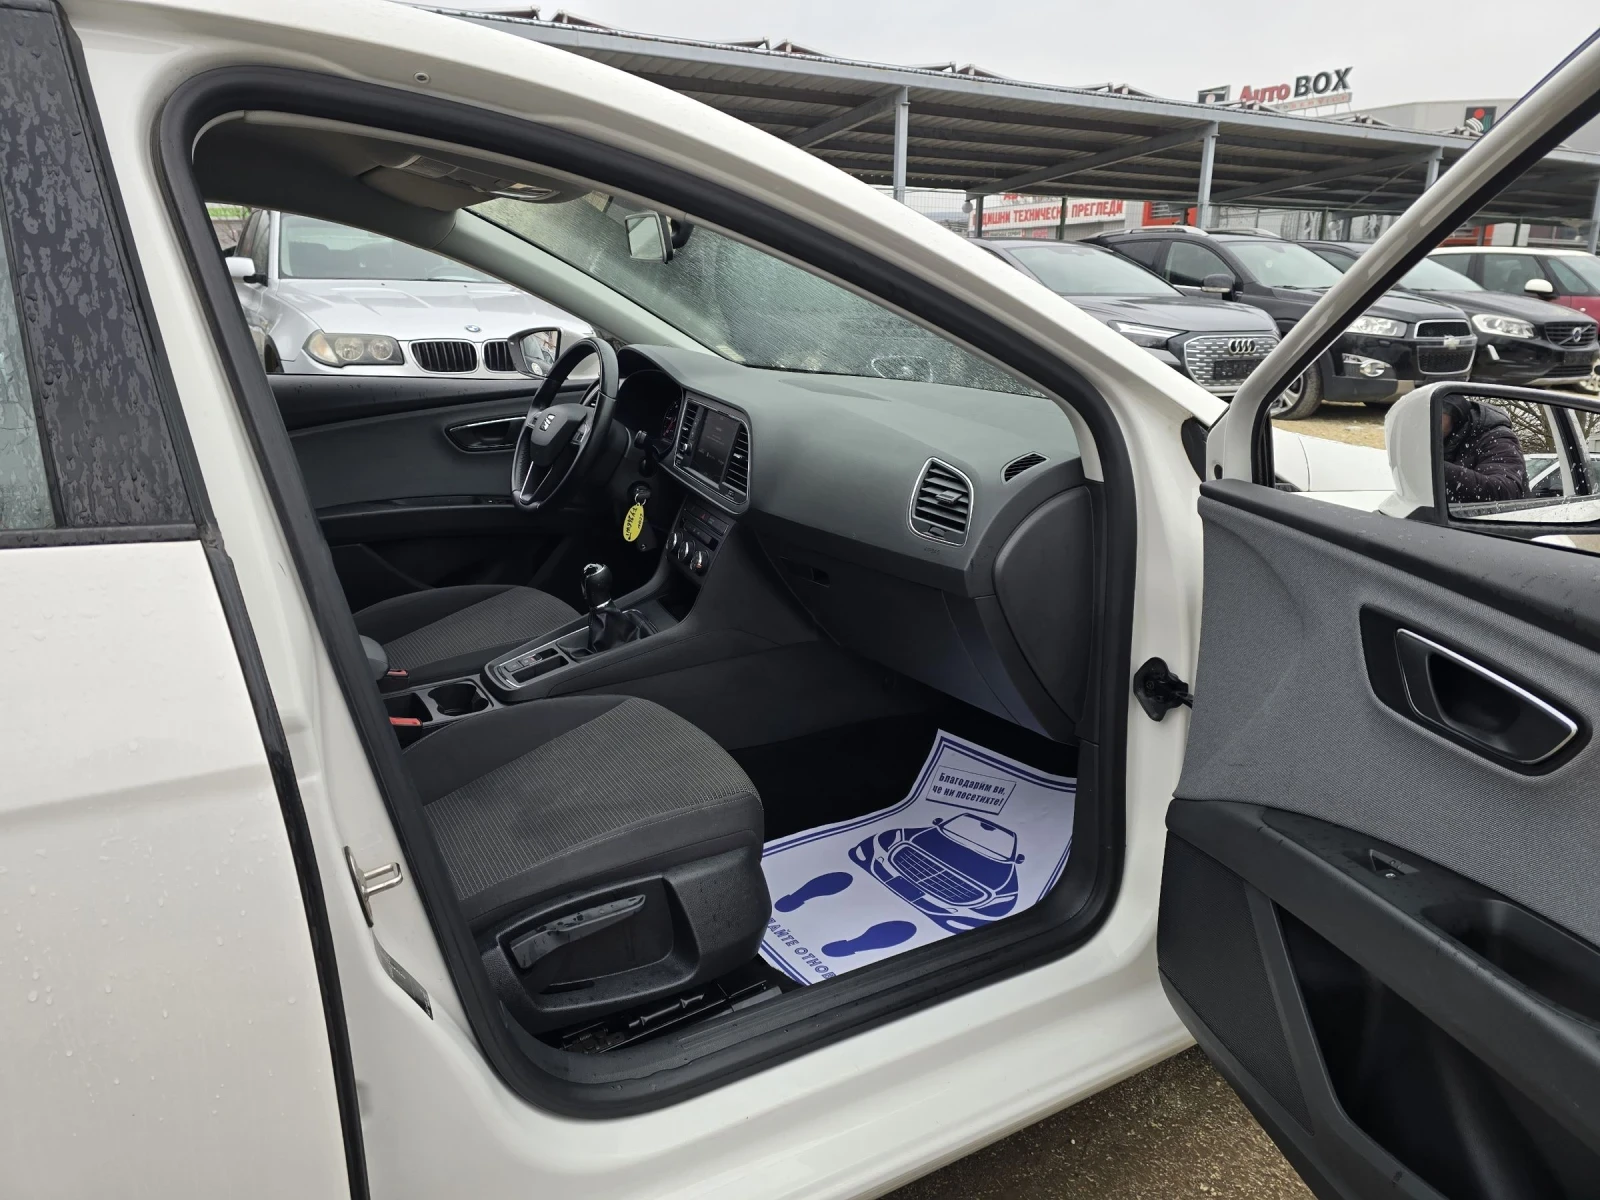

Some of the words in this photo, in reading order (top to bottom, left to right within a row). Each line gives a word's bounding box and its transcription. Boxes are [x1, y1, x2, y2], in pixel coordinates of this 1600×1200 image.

[1294, 67, 1353, 98] BOX
[1072, 200, 1123, 218] ПРЕГЛЕДИ
[939, 772, 992, 793] Благодарим
[993, 787, 1006, 796] ви,
[933, 785, 943, 794] че
[944, 788, 956, 797] ни
[956, 790, 1005, 806] посетихте!
